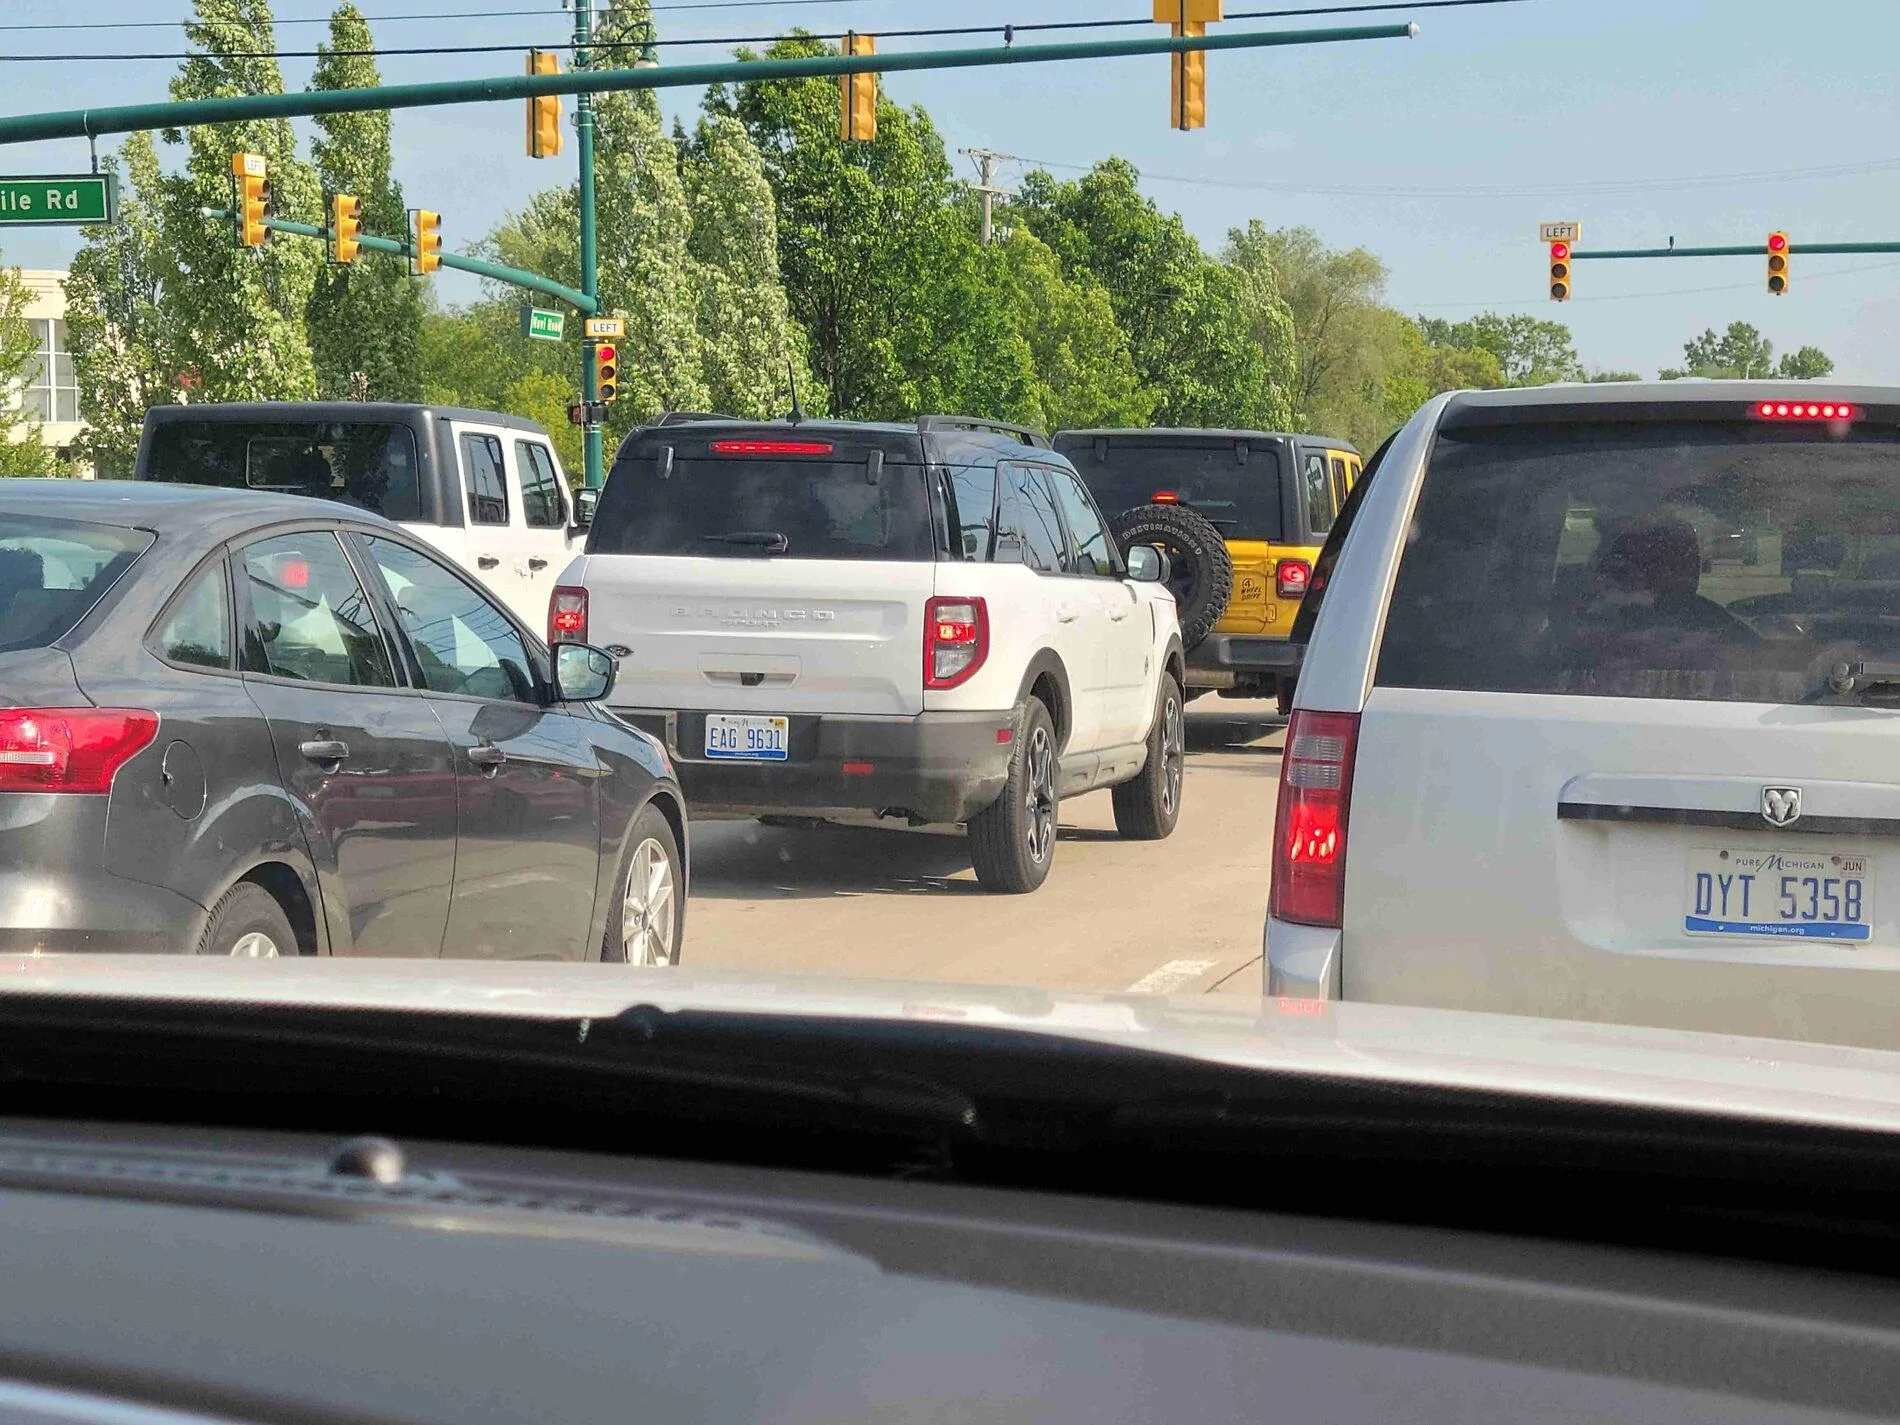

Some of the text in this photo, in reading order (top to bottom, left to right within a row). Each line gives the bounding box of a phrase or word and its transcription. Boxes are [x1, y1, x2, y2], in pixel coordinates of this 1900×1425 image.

[46, 189, 78, 209] Rd
[1546, 227, 1572, 237] LEFT
[593, 323, 617, 332] LEFT
[1122, 523, 1197, 548] DESTINATION
[669, 606, 835, 620] BRONCO
[710, 728, 782, 750] EAG 9631
[1736, 854, 1824, 872] PURE MICHIGAN
[1842, 861, 1862, 871] JUN
[1695, 872, 1862, 922] DYT 5358
[1750, 924, 1805, 935] michigan.org
